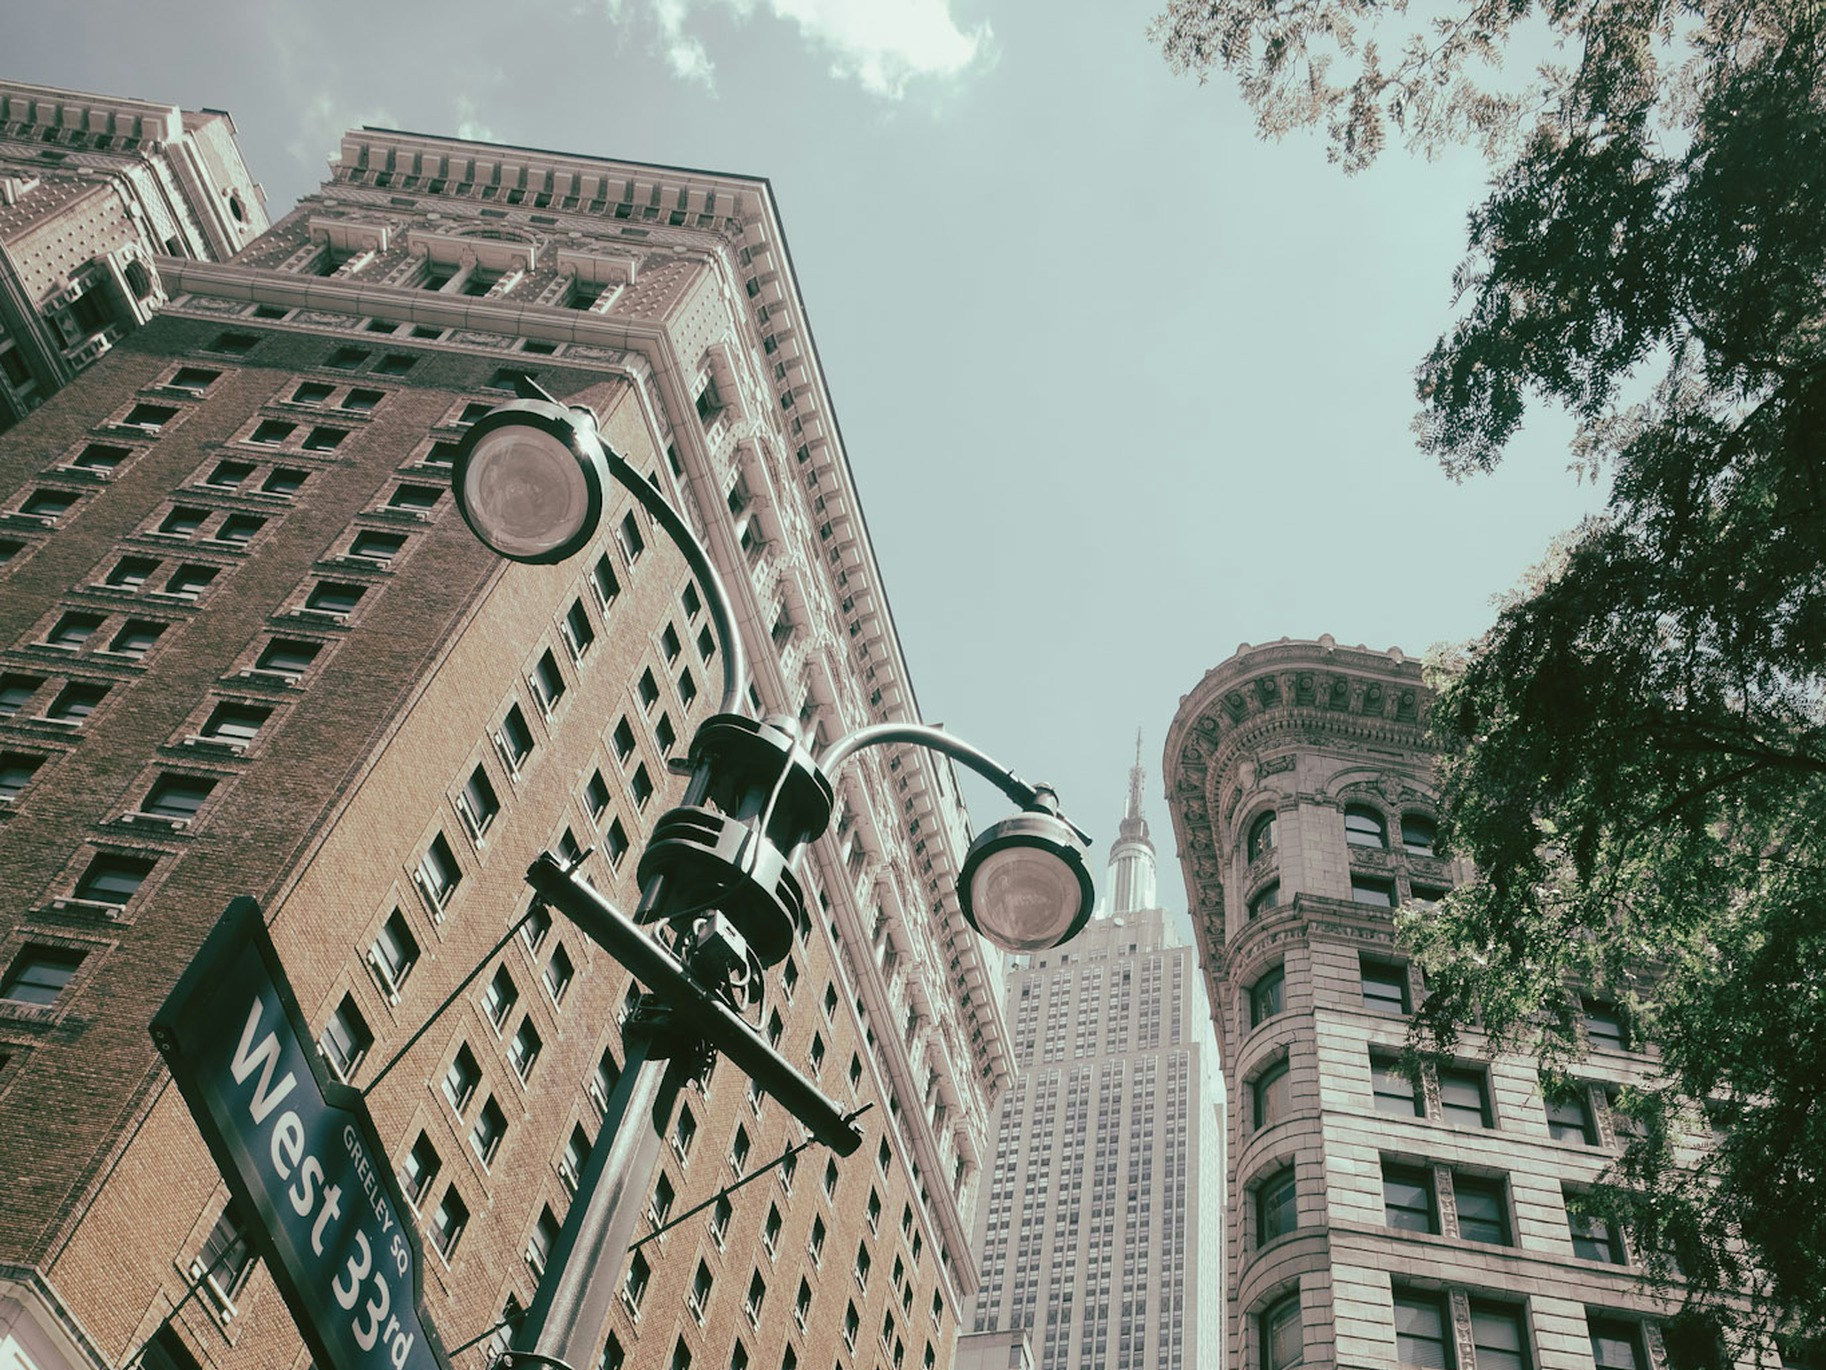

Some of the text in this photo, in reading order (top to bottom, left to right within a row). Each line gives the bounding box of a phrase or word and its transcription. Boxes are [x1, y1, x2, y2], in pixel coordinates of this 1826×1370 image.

[230, 996, 343, 1257] West
[342, 1125, 409, 1278] GREELEY SQ
